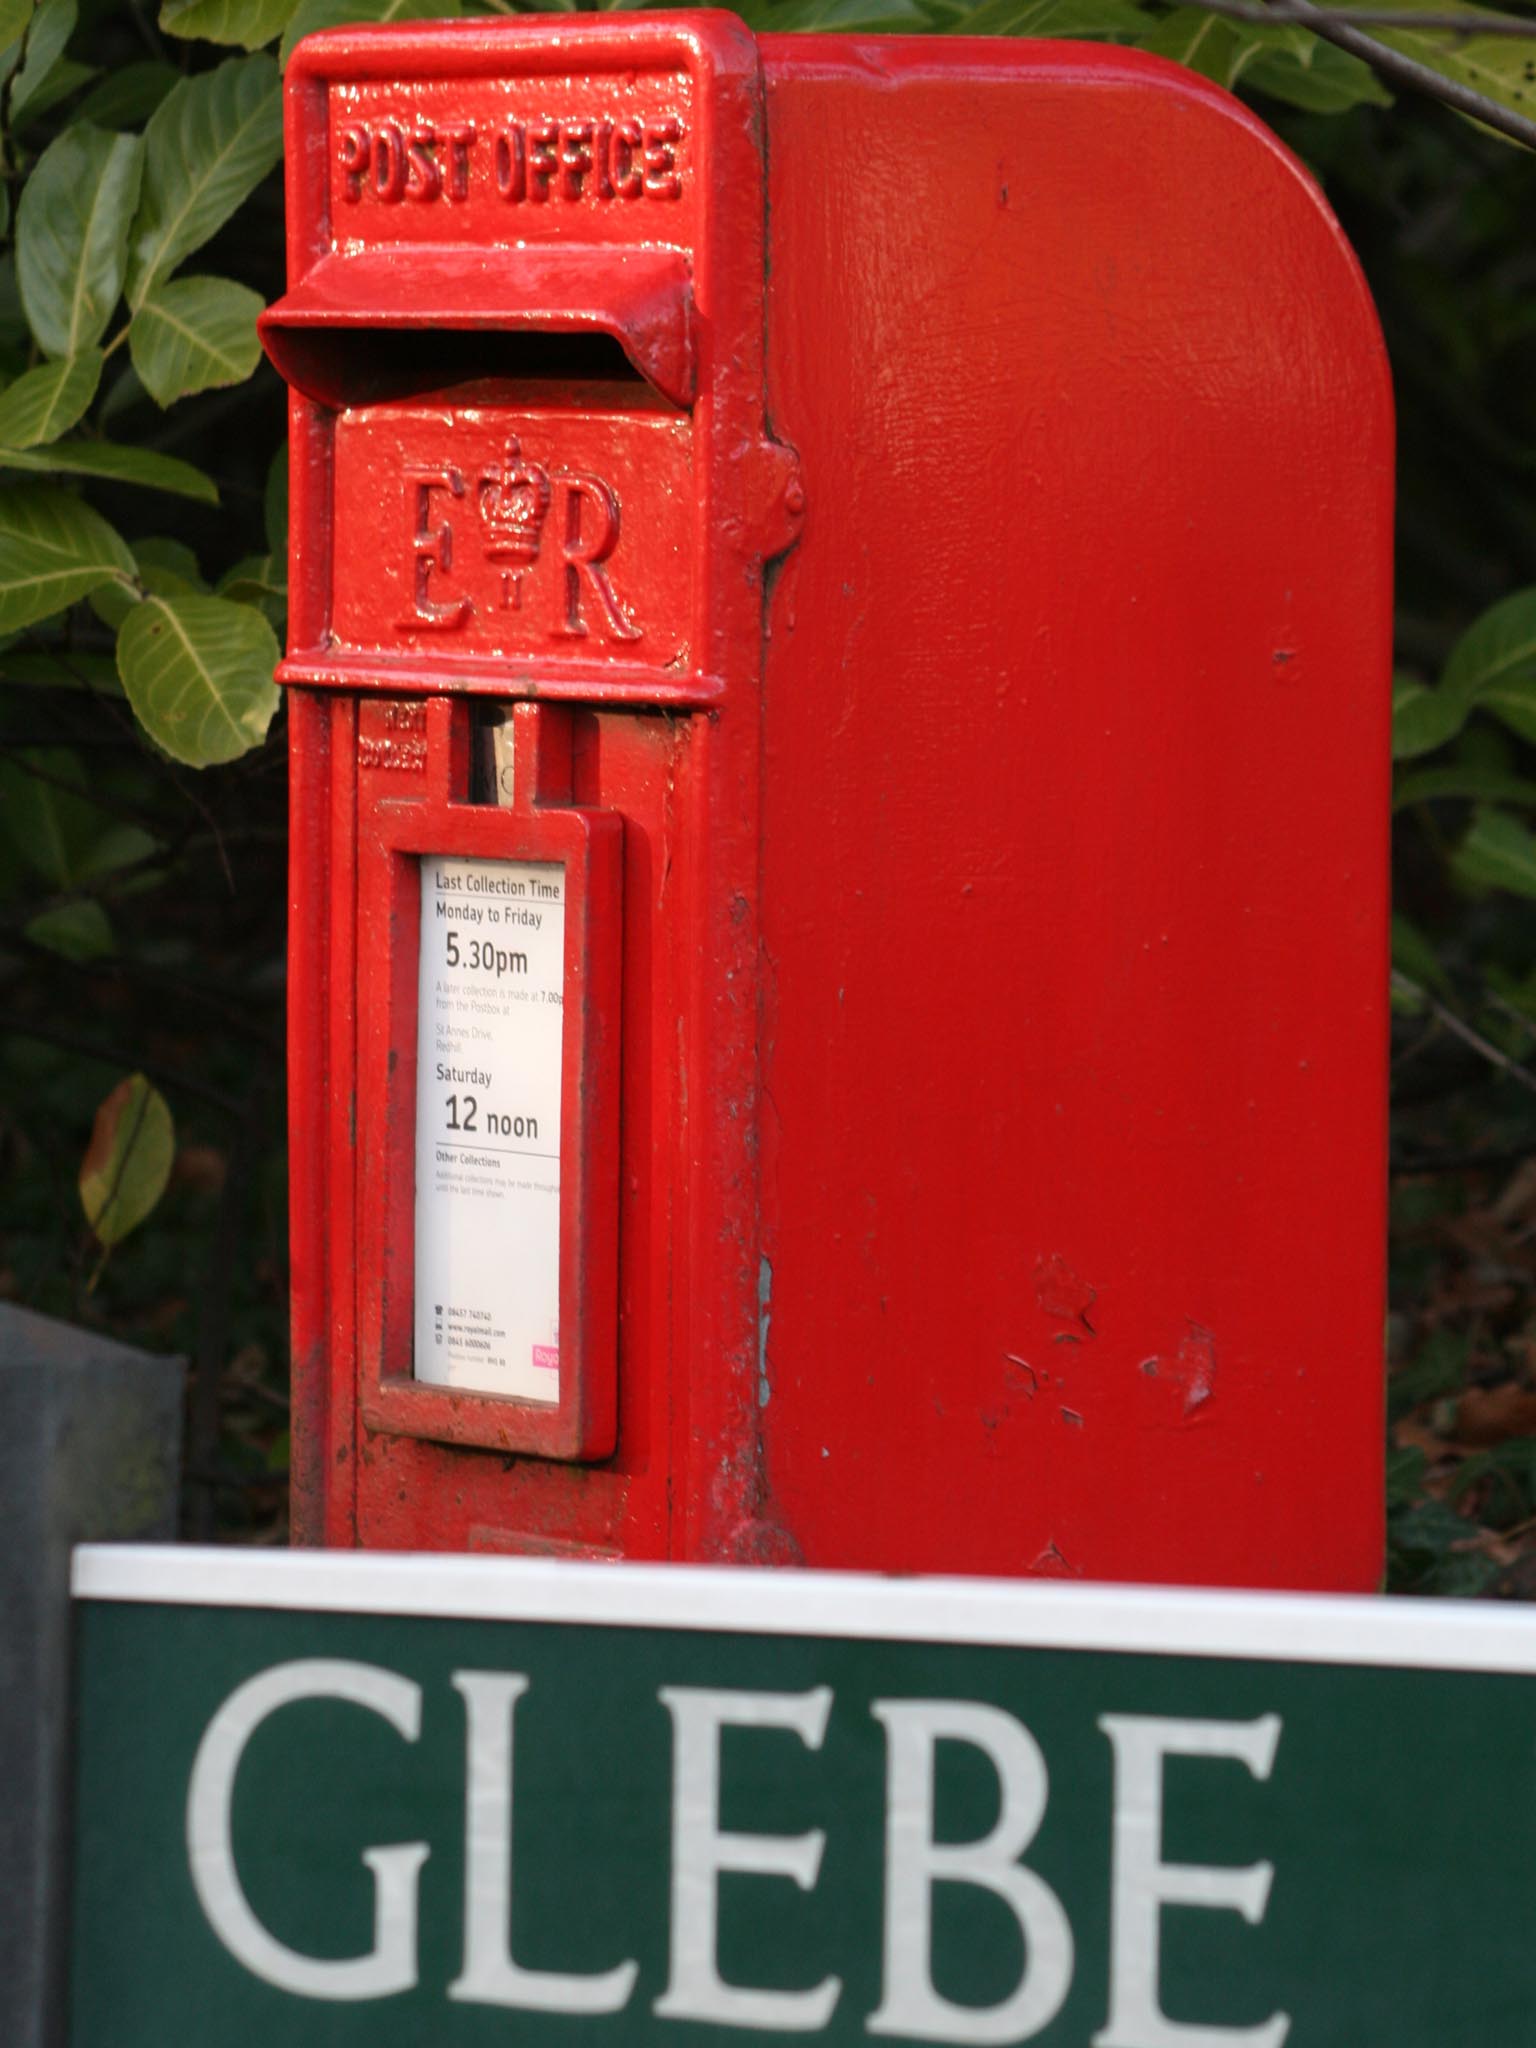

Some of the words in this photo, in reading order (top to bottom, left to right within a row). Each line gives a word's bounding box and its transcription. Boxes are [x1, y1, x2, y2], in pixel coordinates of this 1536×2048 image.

[341, 118, 478, 203] POST
[496, 118, 684, 202] OFFICE
[435, 871, 462, 891] Last
[466, 874, 526, 897] Collection
[530, 879, 560, 899] Time
[436, 901, 484, 925] Monday
[488, 907, 500, 923] to
[504, 907, 543, 931] Friday
[446, 931, 528, 979] 5.30pm
[436, 1063, 492, 1089] Saturday
[445, 1094, 478, 1132] 12
[487, 1112, 539, 1140] noon
[436, 1150, 458, 1163] Other
[460, 1152, 501, 1168] Collections
[186, 1657, 1291, 2048] GLEBE
